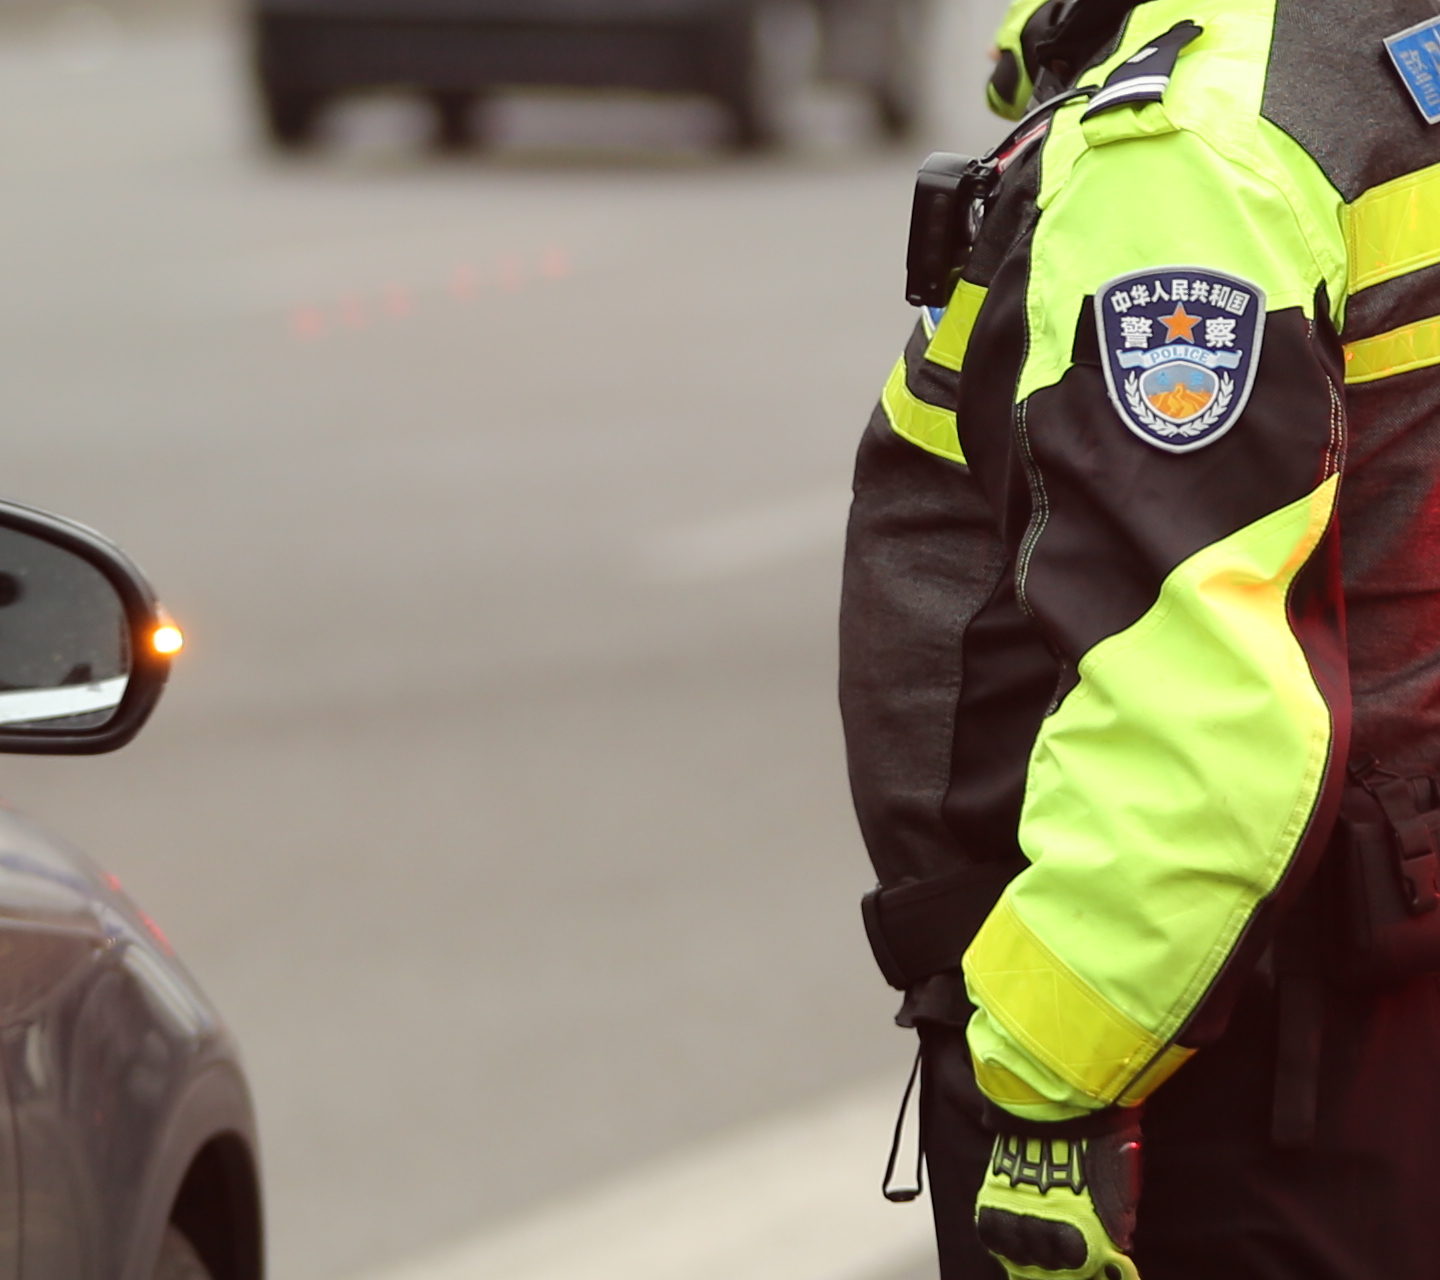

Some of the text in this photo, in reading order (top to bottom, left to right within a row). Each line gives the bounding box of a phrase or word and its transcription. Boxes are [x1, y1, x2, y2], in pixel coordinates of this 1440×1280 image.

[1110, 279, 1251, 316] 中华人民共和国
[1120, 316, 1237, 349] 警 察
[1150, 347, 1209, 364] POLICE
